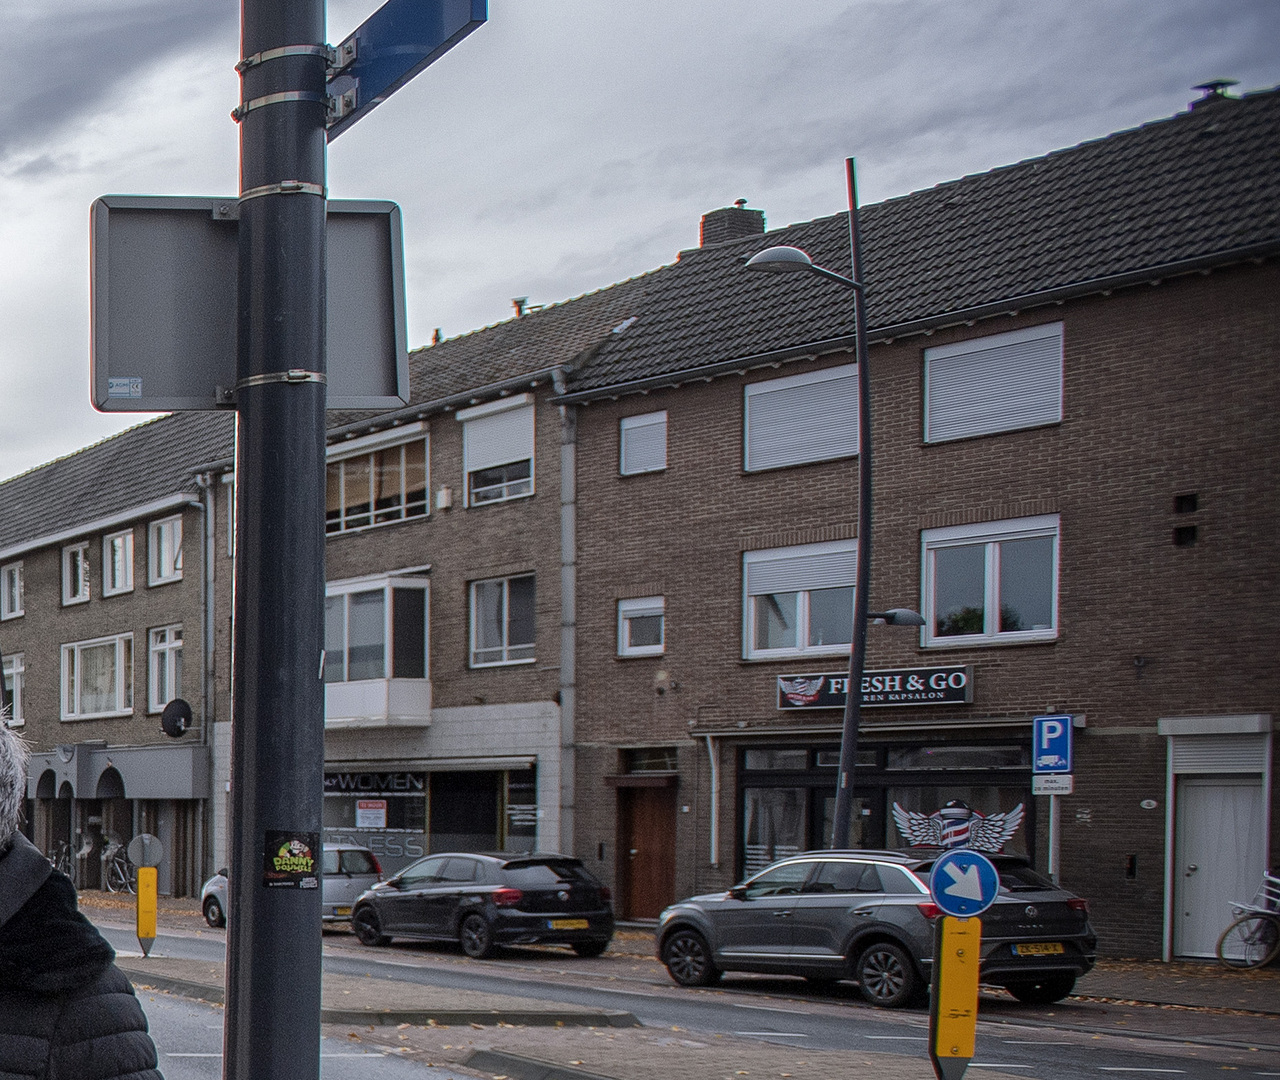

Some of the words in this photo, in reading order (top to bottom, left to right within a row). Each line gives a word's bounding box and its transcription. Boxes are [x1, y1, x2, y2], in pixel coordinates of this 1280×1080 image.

[828, 675, 904, 695] FESH
[906, 674, 926, 691] &
[929, 672, 968, 690] GO
[888, 691, 945, 701] KAPSALON
[1041, 721, 1064, 749] P
[338, 773, 424, 790] WOMEN
[273, 856, 315, 867] DANNY
